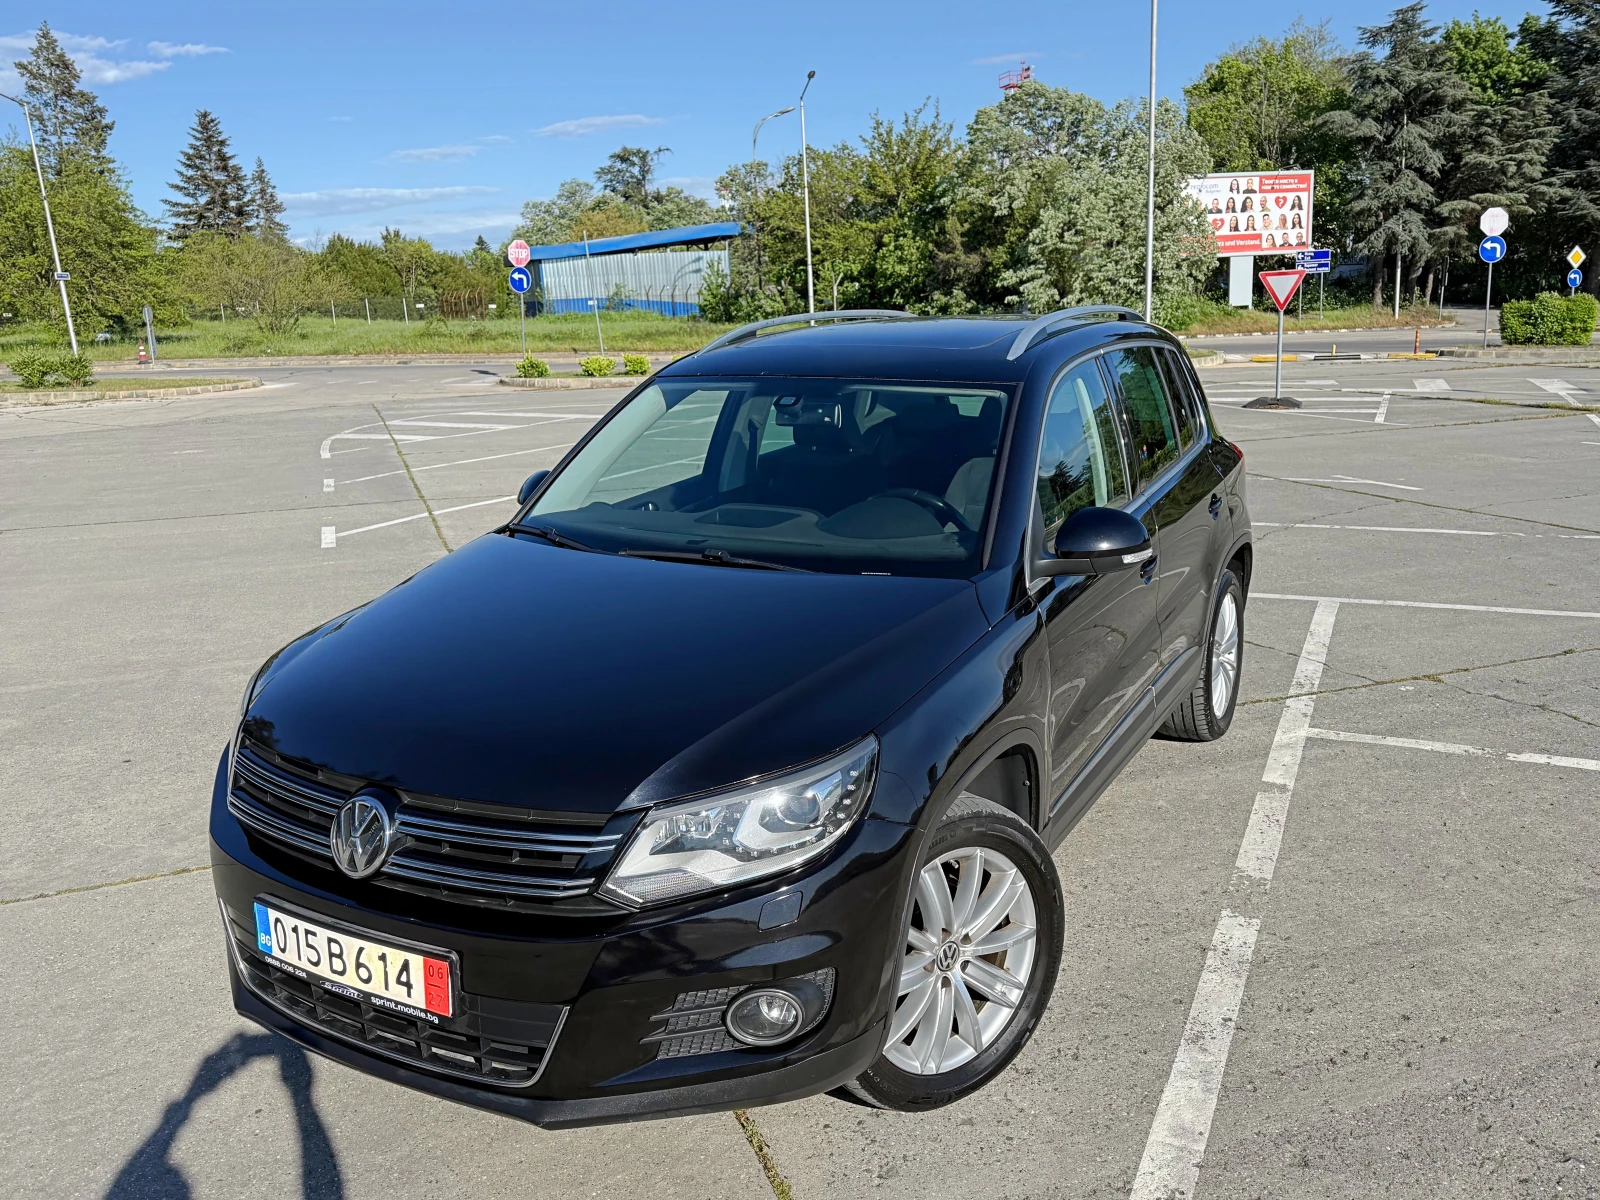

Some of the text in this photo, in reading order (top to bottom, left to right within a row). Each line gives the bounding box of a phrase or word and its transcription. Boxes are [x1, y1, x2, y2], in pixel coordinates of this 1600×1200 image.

[1236, 238, 1261, 246] Verstand.
[510, 249, 528, 258] STOP
[260, 933, 272, 947] BG
[274, 917, 413, 998] 015B614
[427, 964, 443, 980] 06
[428, 991, 444, 1007] 27
[370, 996, 439, 1024] sprint.mobile.bg
